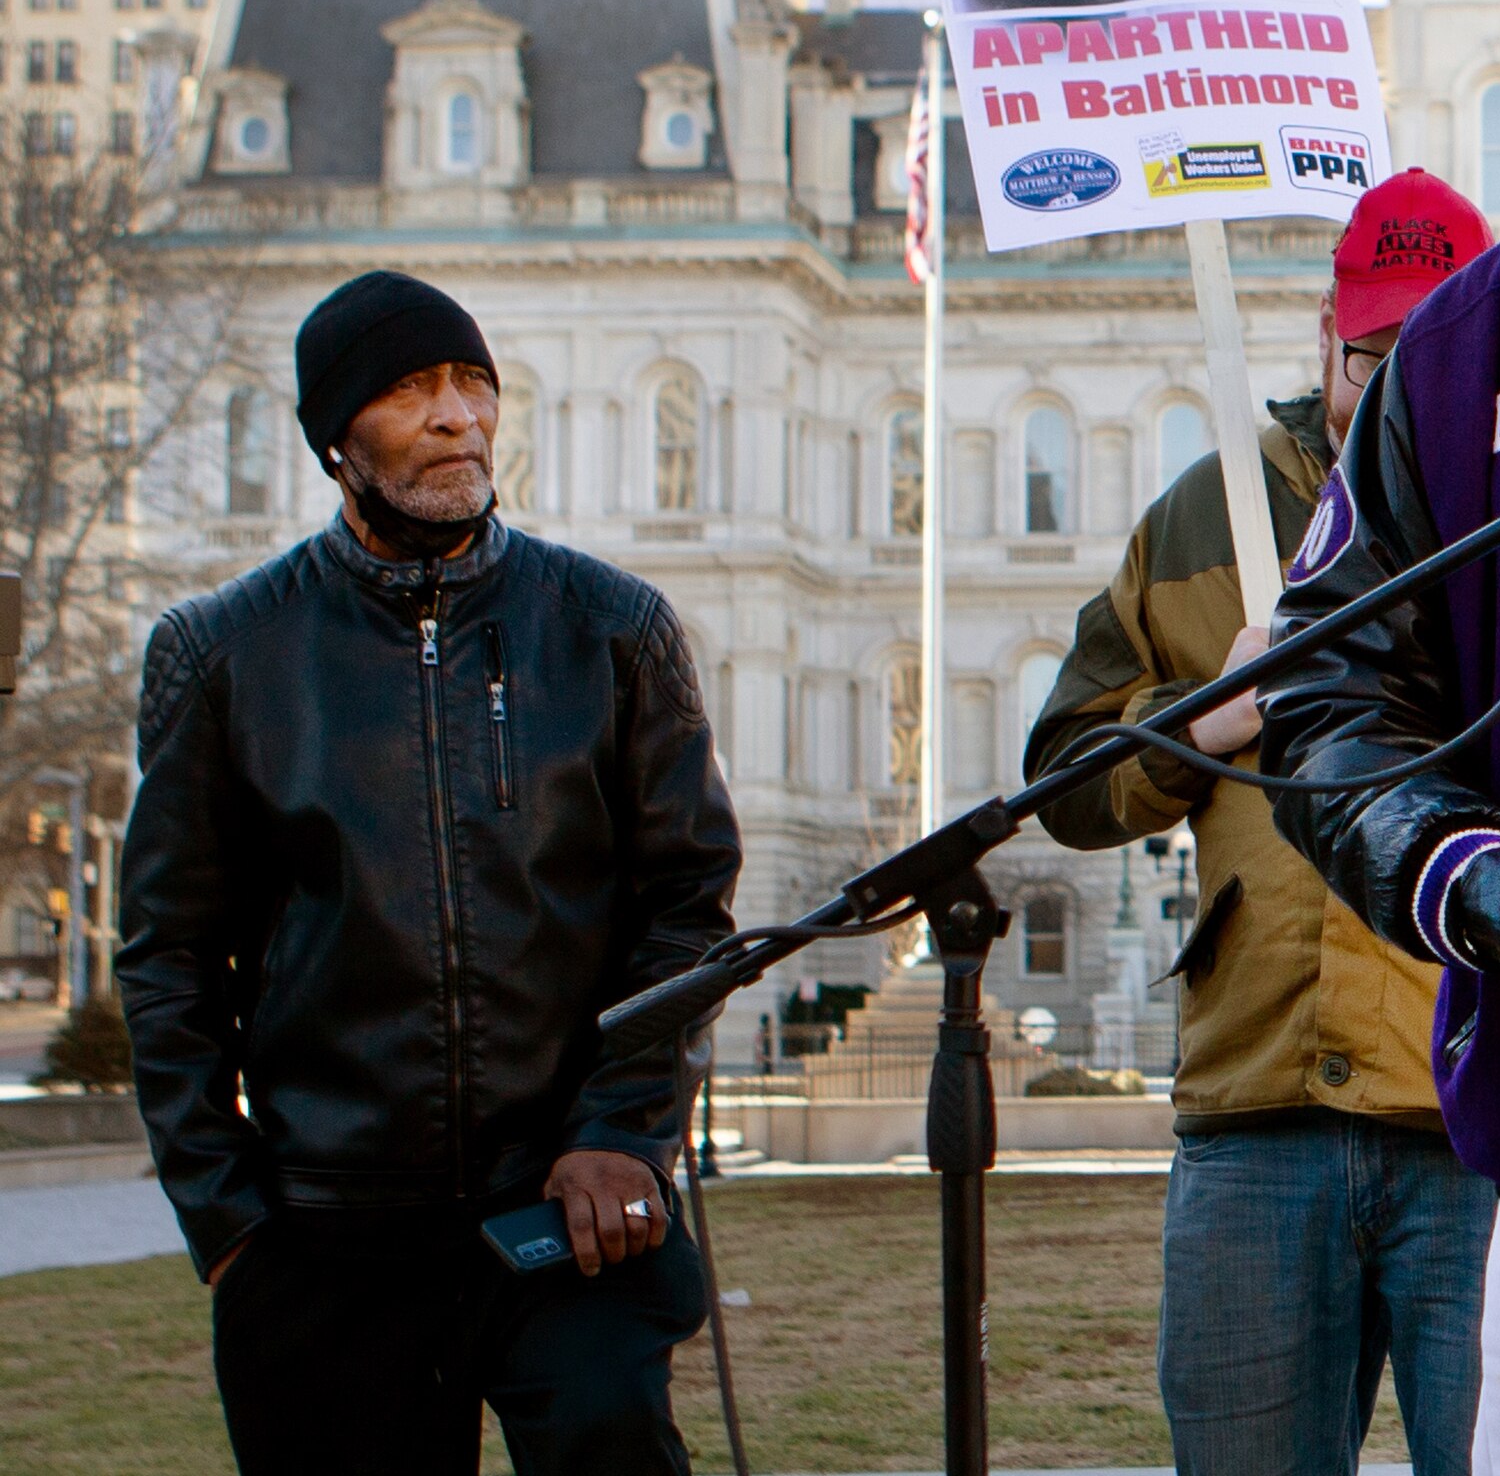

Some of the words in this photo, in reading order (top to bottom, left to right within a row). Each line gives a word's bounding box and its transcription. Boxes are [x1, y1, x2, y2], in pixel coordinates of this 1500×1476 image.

[972, 10, 1350, 69] APARTHEID
[982, 86, 1040, 127] in
[1061, 68, 1359, 121] Baltimore
[1186, 149, 1257, 163] Unemployed
[1288, 137, 1366, 159] BALTO
[1019, 153, 1097, 175] WELCOME
[1184, 163, 1231, 176] Workers
[1230, 162, 1263, 174] Union
[1291, 152, 1369, 189] PPA
[1009, 175, 1059, 191] MATTHEW
[1381, 218, 1449, 237] BLACK
[1379, 233, 1447, 256] LIVES
[1370, 254, 1456, 272] MATTER
